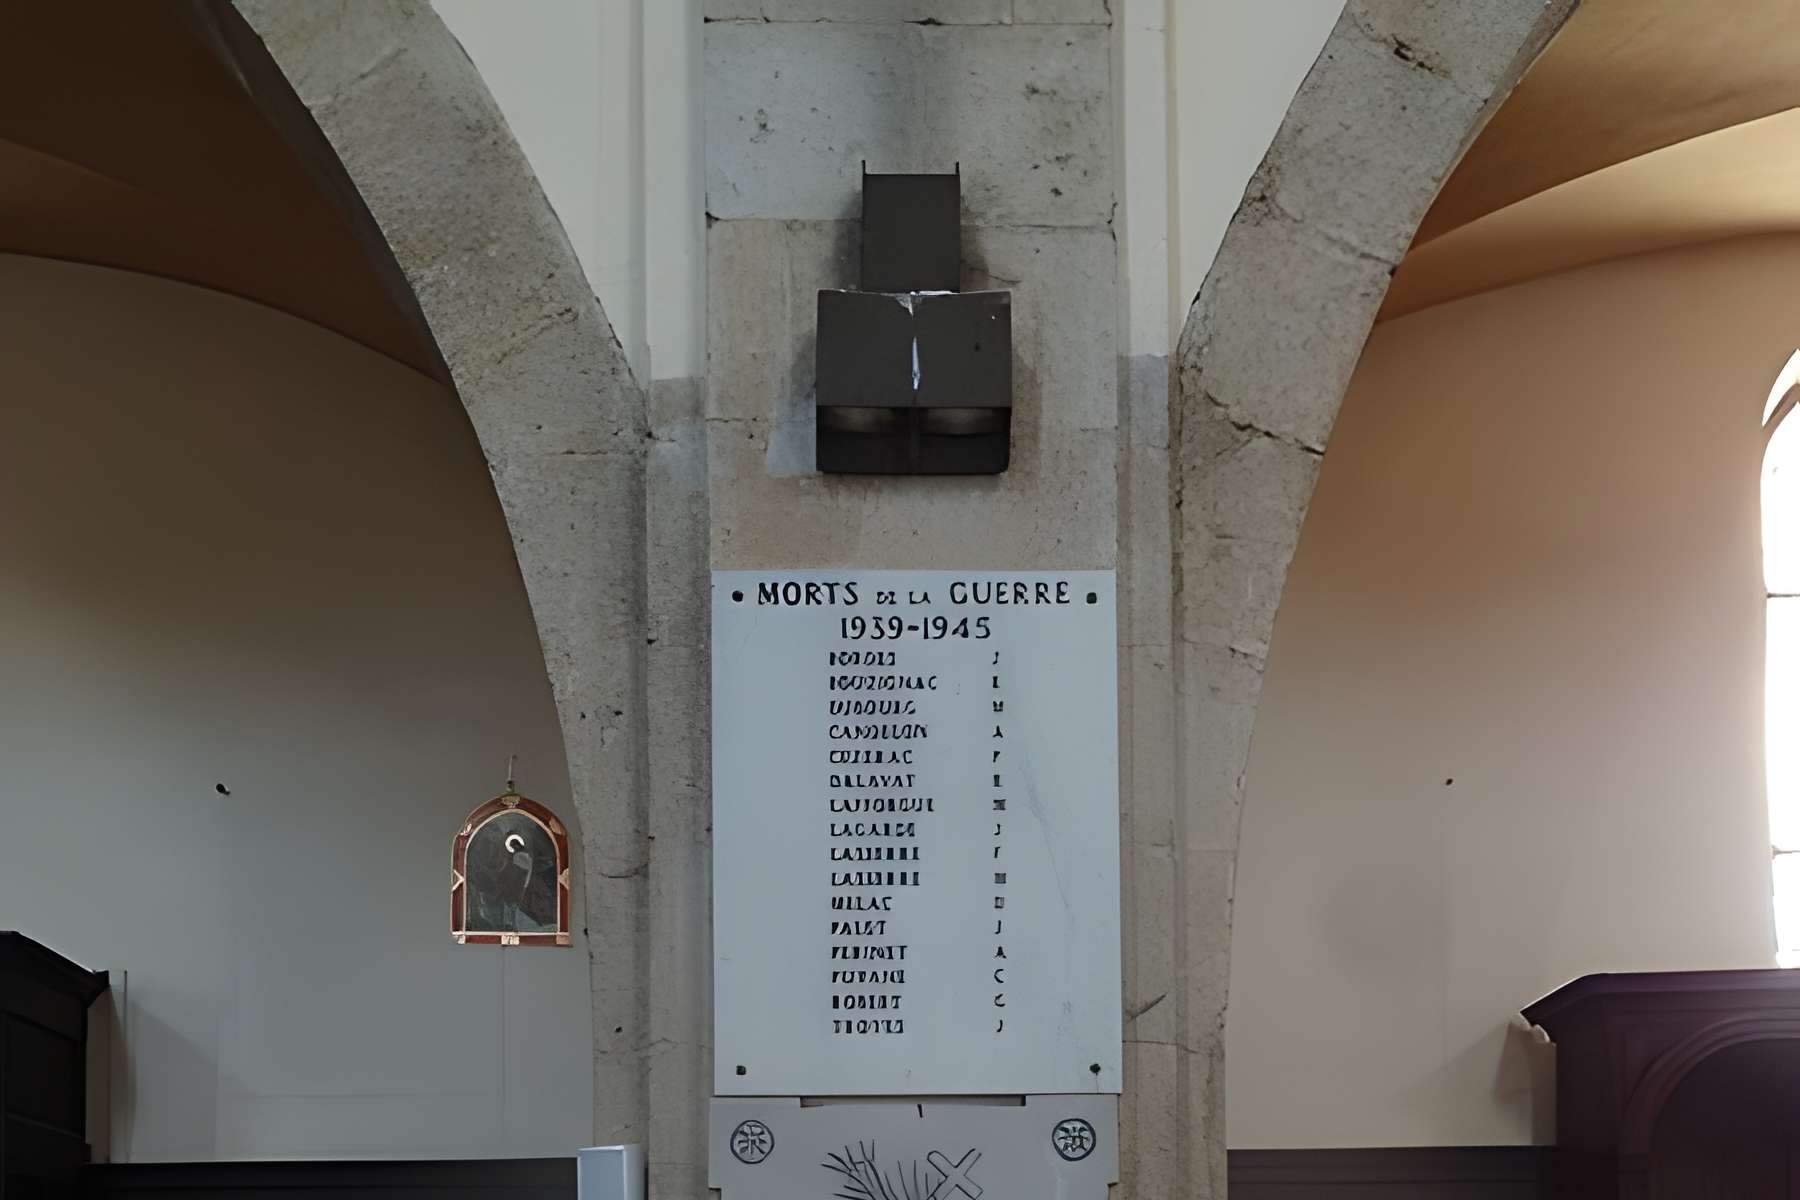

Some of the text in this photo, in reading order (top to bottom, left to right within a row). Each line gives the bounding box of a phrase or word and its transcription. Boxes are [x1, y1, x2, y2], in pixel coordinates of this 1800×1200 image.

[758, 581, 858, 606] MORTS
[909, 591, 931, 604] LA
[950, 581, 1070, 605] GUERRE
[841, 616, 990, 640] 1939-1945
